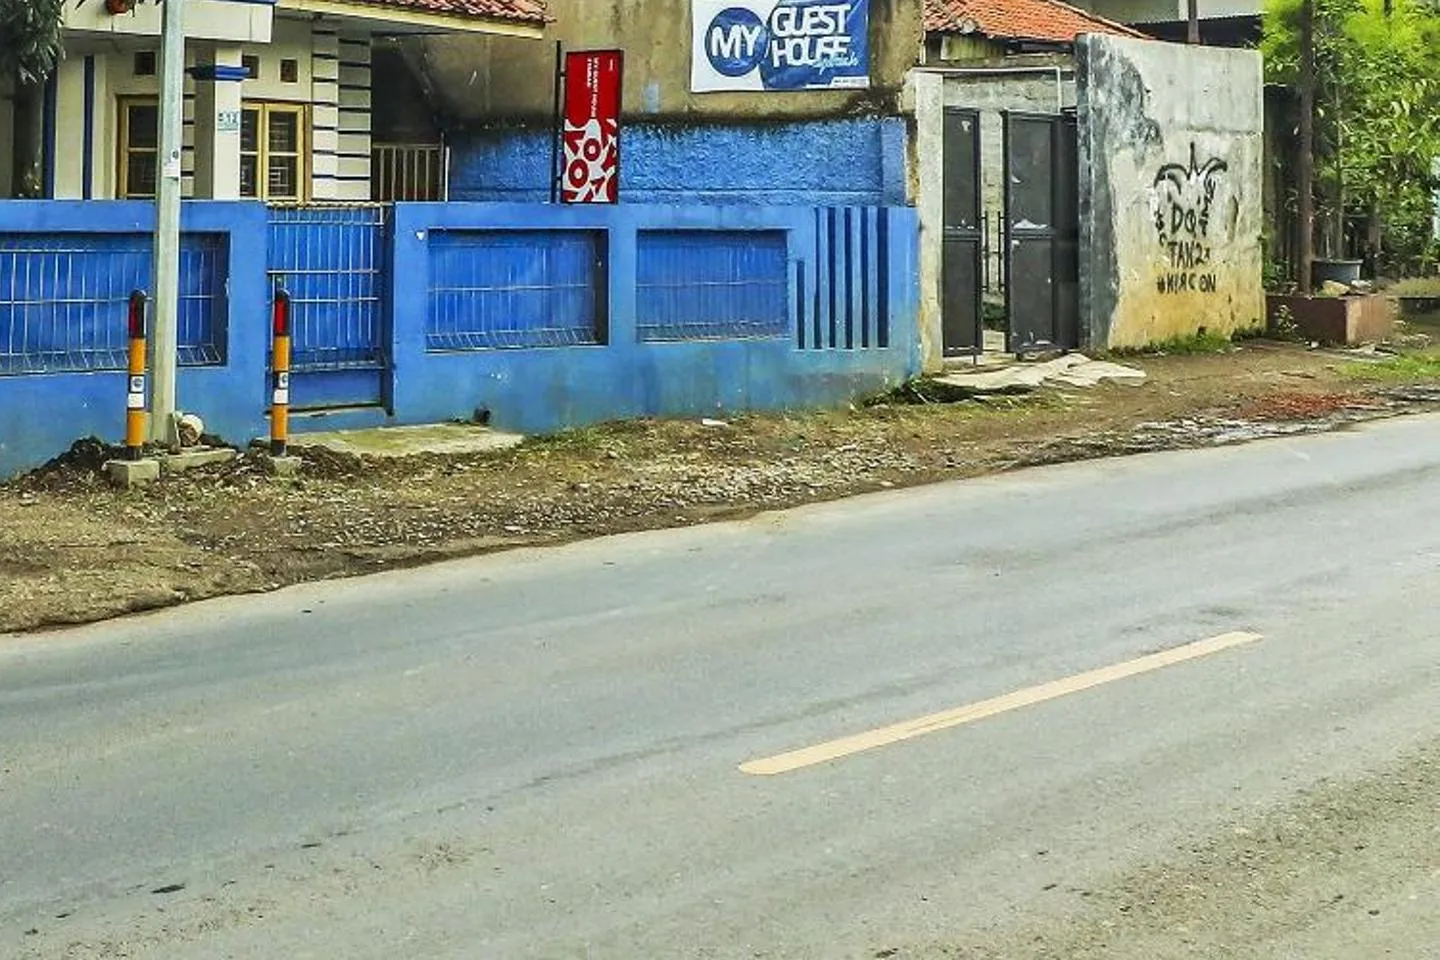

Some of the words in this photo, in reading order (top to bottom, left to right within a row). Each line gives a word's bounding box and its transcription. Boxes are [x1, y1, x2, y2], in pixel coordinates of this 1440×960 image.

[771, 3, 852, 37] GUEST
[712, 24, 762, 59] MY
[771, 36, 852, 68] HOUSE
